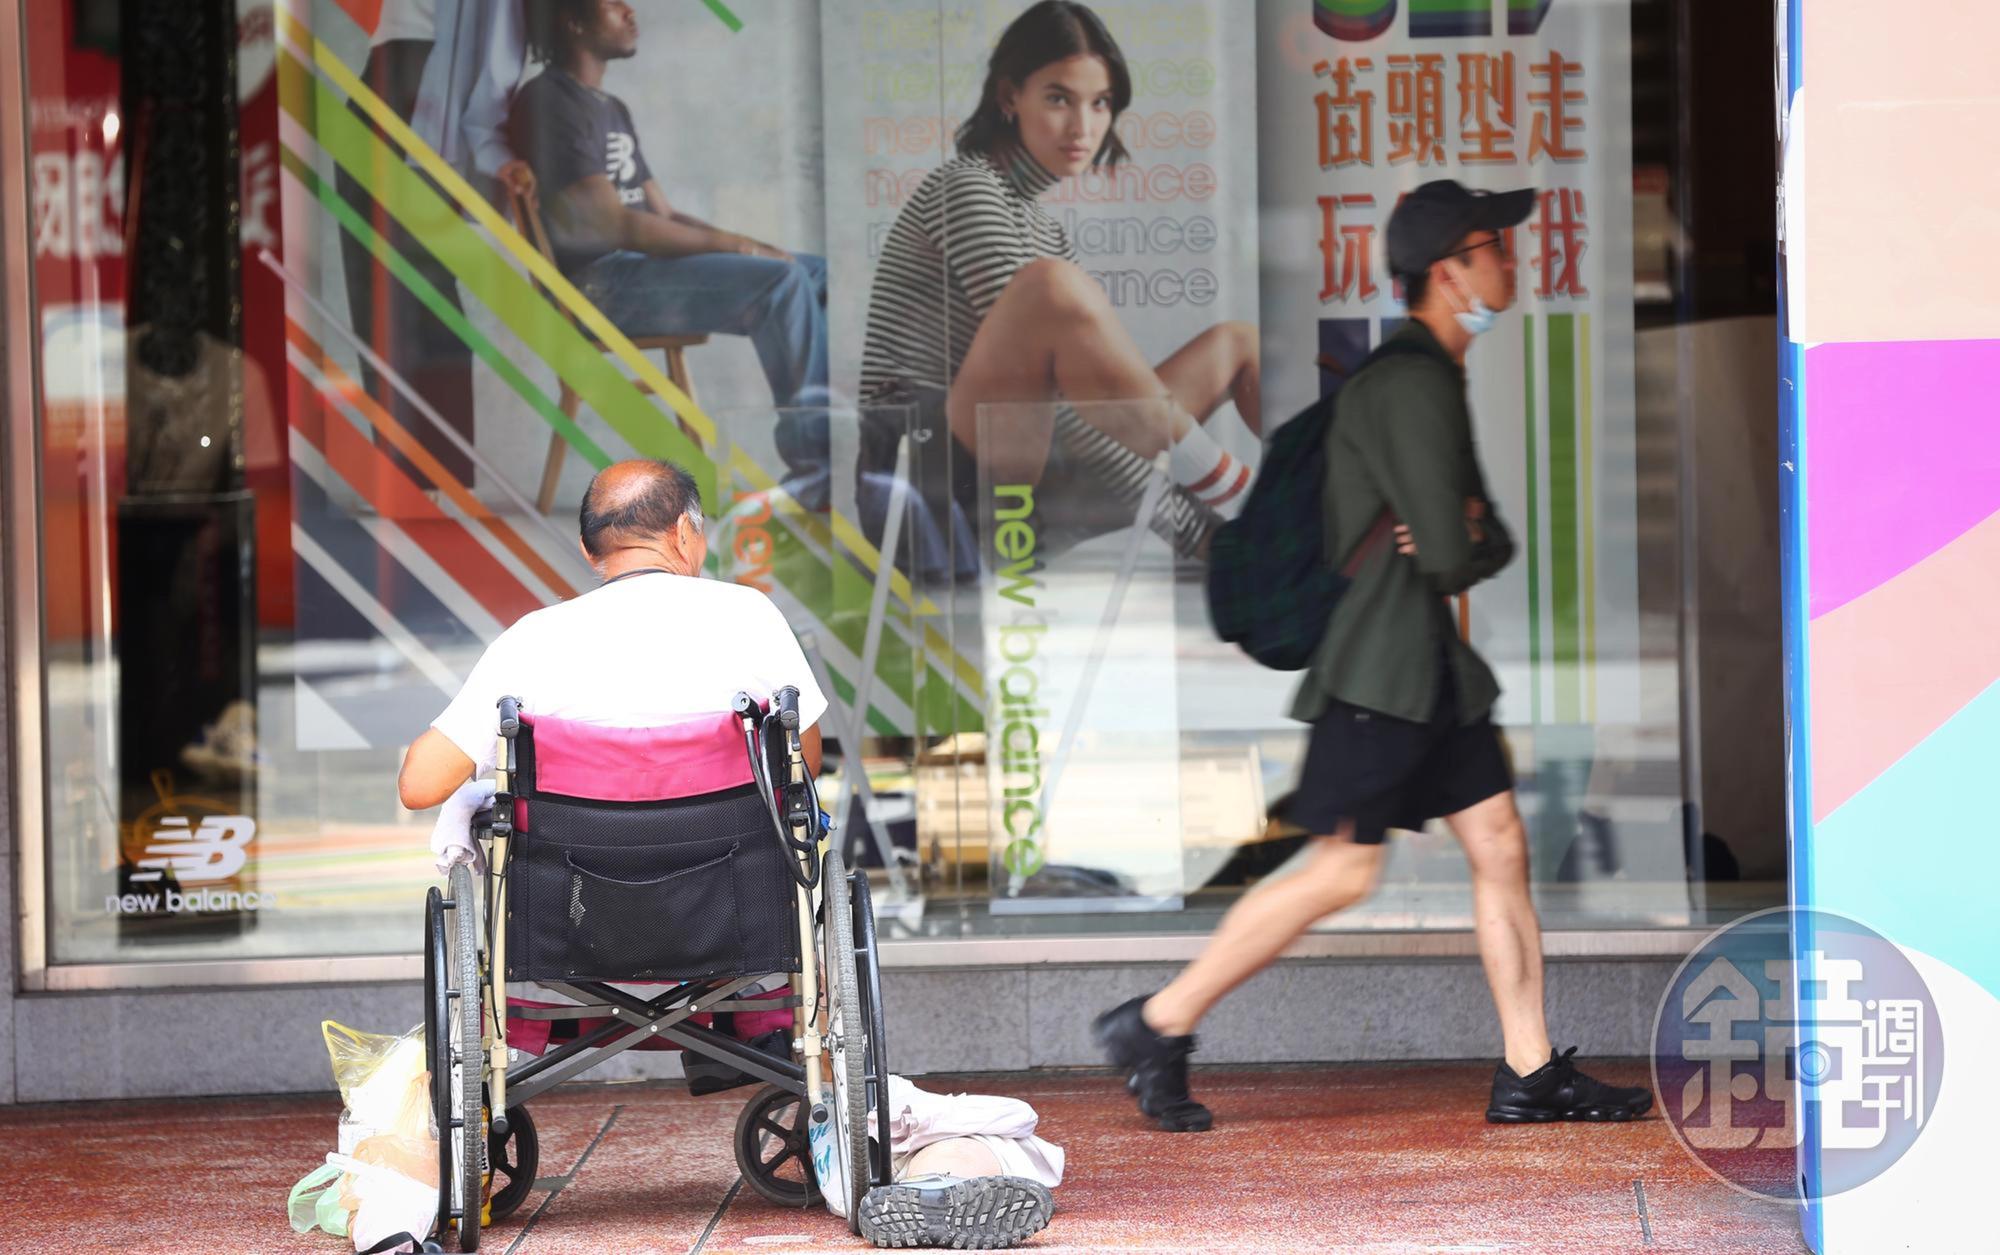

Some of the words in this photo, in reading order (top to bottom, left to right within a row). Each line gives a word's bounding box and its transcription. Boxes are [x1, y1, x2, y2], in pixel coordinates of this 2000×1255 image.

[1064, 208, 1217, 255] lance
[994, 485, 1036, 607] new
[998, 624, 1050, 877] balance
[105, 893, 160, 913] new
[165, 887, 276, 912] balance
